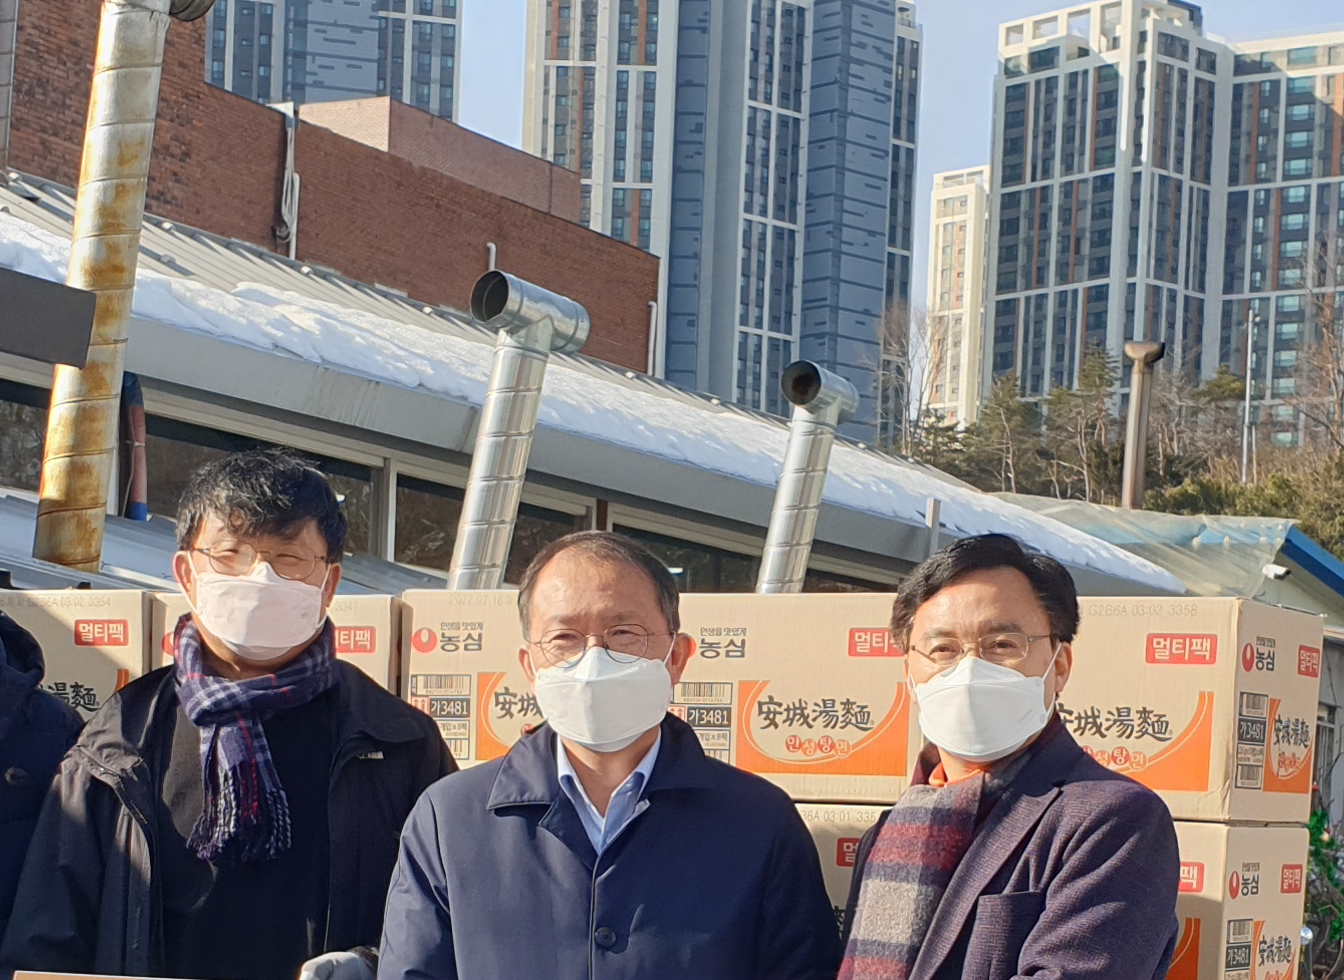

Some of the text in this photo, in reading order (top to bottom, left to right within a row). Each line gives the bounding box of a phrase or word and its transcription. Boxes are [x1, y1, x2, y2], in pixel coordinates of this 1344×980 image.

[78, 622, 124, 643] 멀티팩
[335, 629, 371, 650] 티팩
[439, 632, 483, 653] 농심
[854, 631, 896, 653] 멀티
[699, 638, 746, 659] 농심
[1152, 637, 1211, 661] 멀티팩
[1256, 648, 1276, 672] 농심
[39, 682, 100, 712] 湯麵
[494, 686, 545, 719] 安城
[431, 700, 469, 716] 가3481
[688, 708, 729, 725] 가3481
[757, 695, 874, 732] 安城湯麵
[786, 735, 850, 756] 안성탕면
[1241, 873, 1260, 897] 농심
